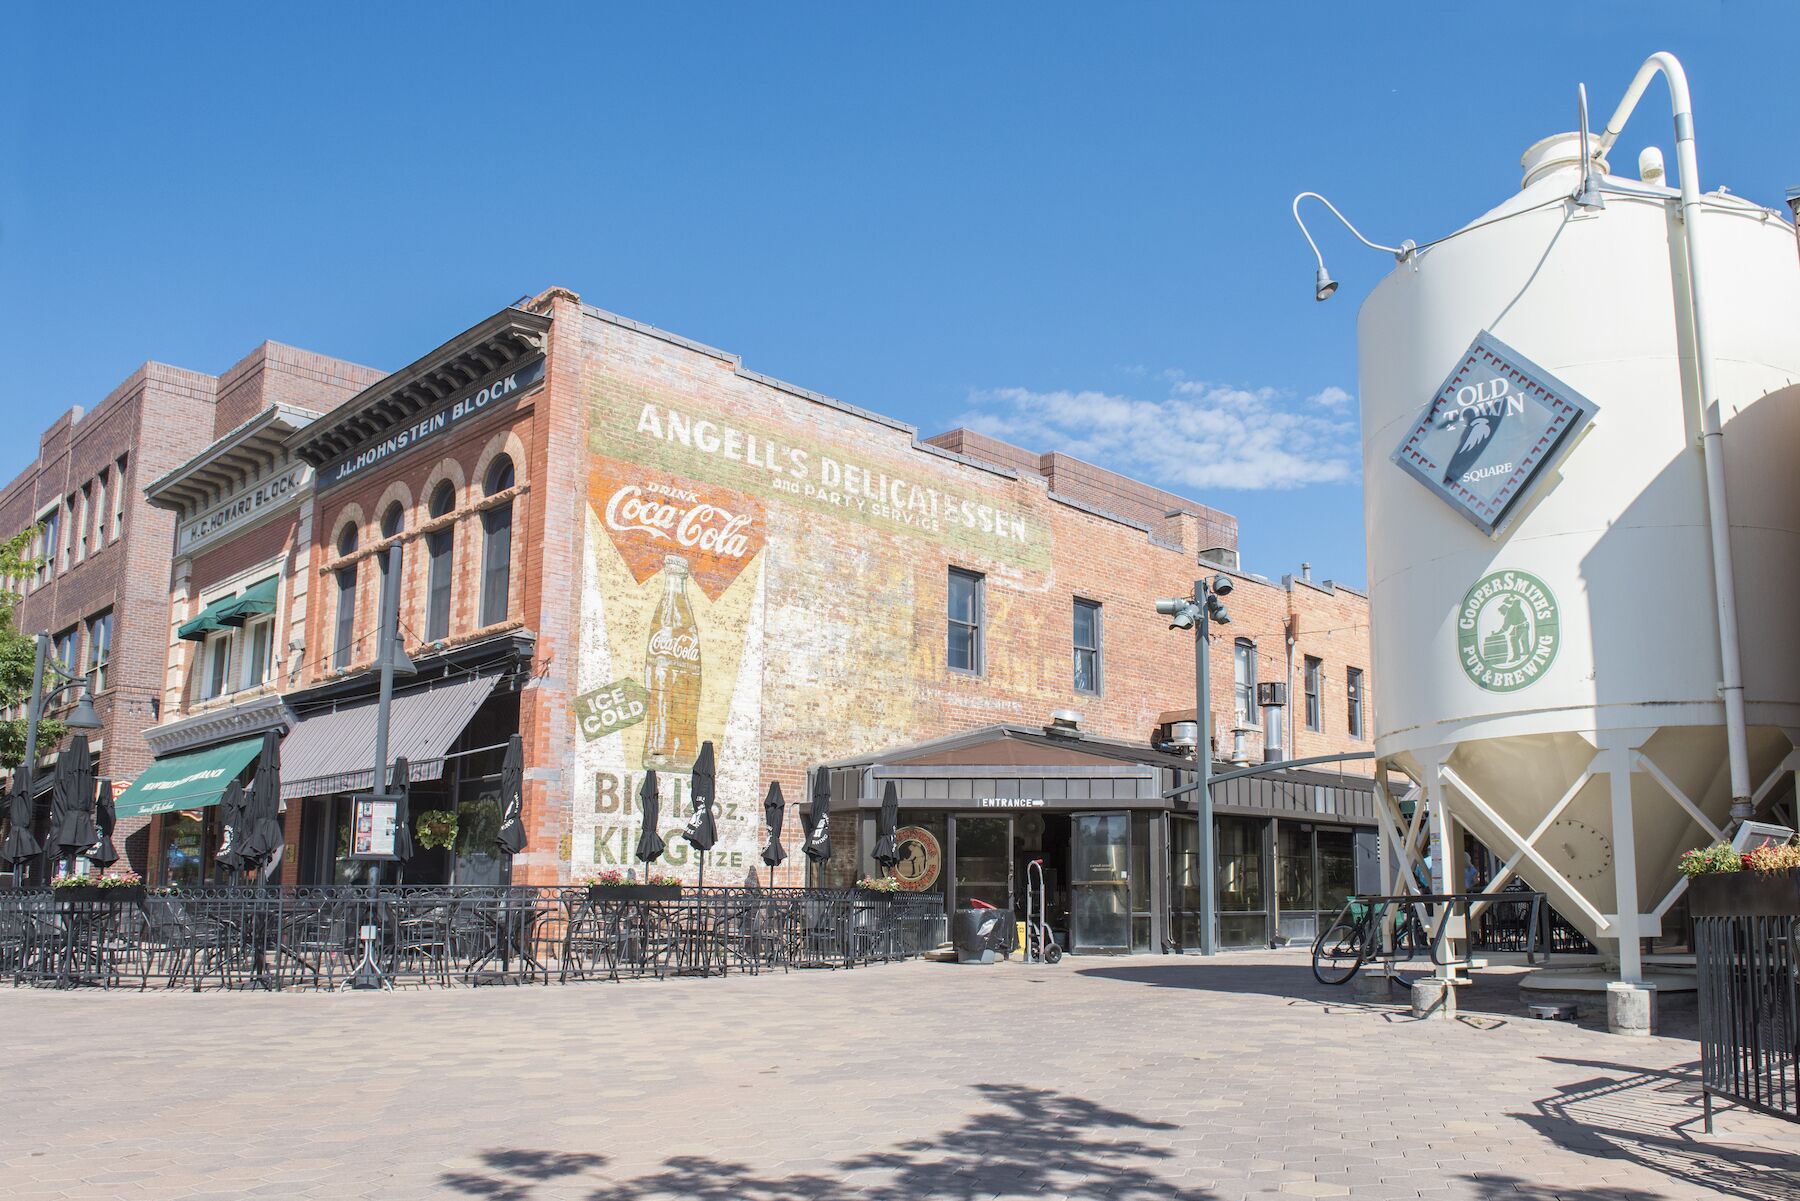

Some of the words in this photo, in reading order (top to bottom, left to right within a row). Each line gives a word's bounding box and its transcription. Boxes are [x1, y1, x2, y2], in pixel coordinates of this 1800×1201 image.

[452, 374, 518, 421] BLOCK
[1456, 377, 1509, 407] OLD
[1443, 392, 1525, 431] TOWN
[636, 402, 809, 480] ANGELL'S
[821, 456, 1026, 543] DELICATESSEN
[1462, 462, 1513, 482] SQUARE
[646, 481, 703, 503] DRINK
[773, 478, 800, 494] and
[804, 483, 865, 511] PARTY
[871, 503, 940, 532] SERVICE
[1463, 645, 1484, 676] PUB
[1481, 669, 1493, 684] &
[1492, 635, 1554, 687] BREWING
[587, 687, 626, 714] ICE
[583, 700, 644, 734] COLD
[982, 798, 1032, 807] ENTRANCE
[692, 850, 743, 867] SIZE
